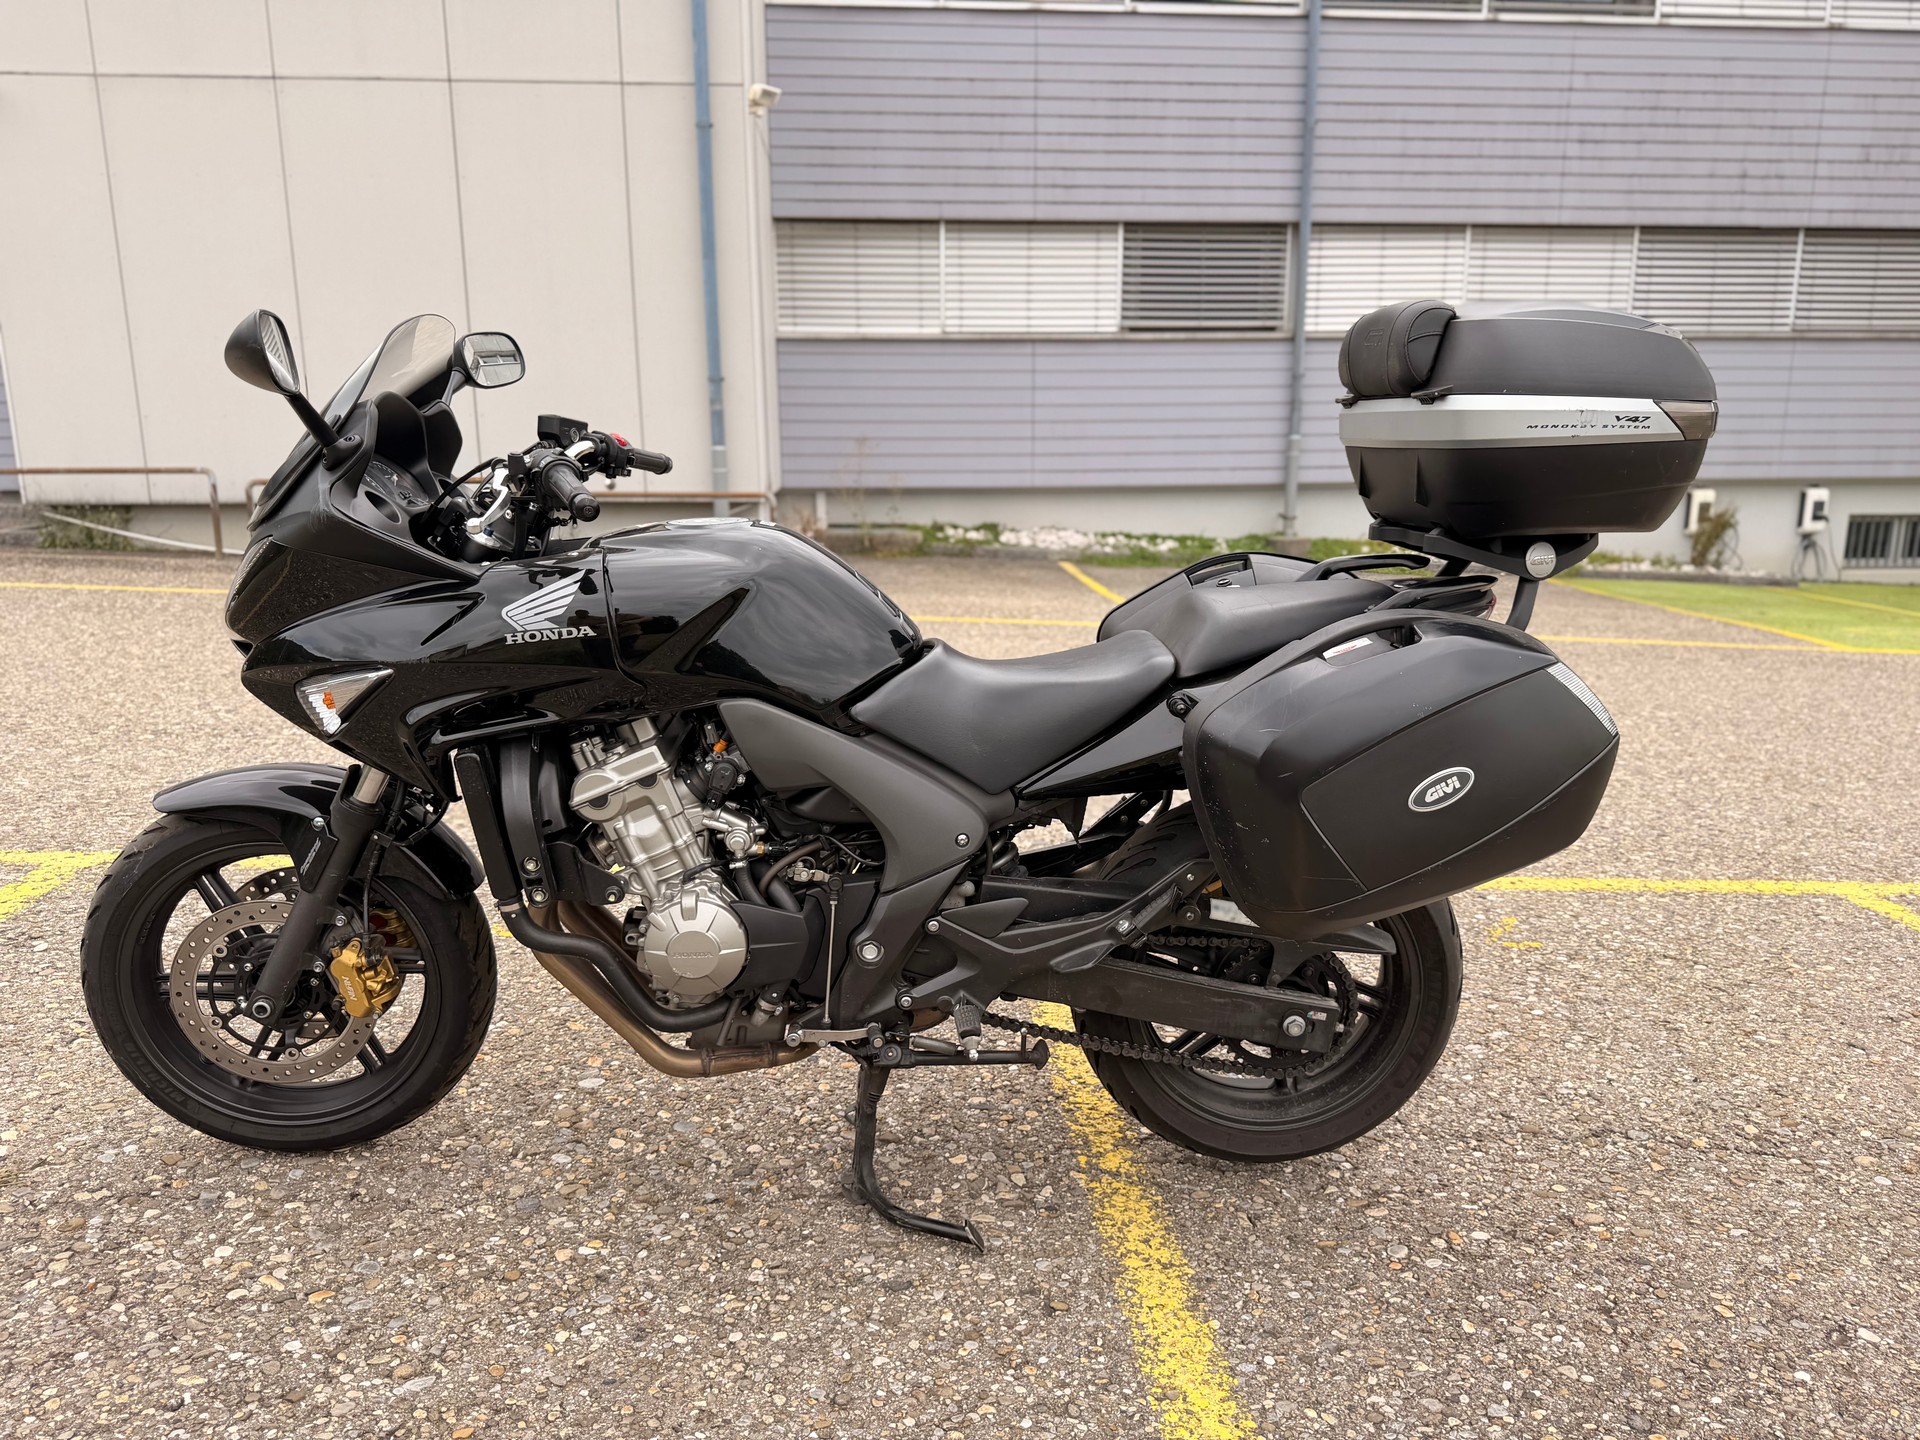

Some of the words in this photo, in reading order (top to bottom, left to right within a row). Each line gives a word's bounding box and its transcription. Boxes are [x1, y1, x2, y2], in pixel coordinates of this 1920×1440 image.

[1614, 415, 1651, 423] V47
[504, 625, 597, 645] HONDA
[1424, 775, 1461, 803] GIVI
[672, 951, 714, 959] HONDA
